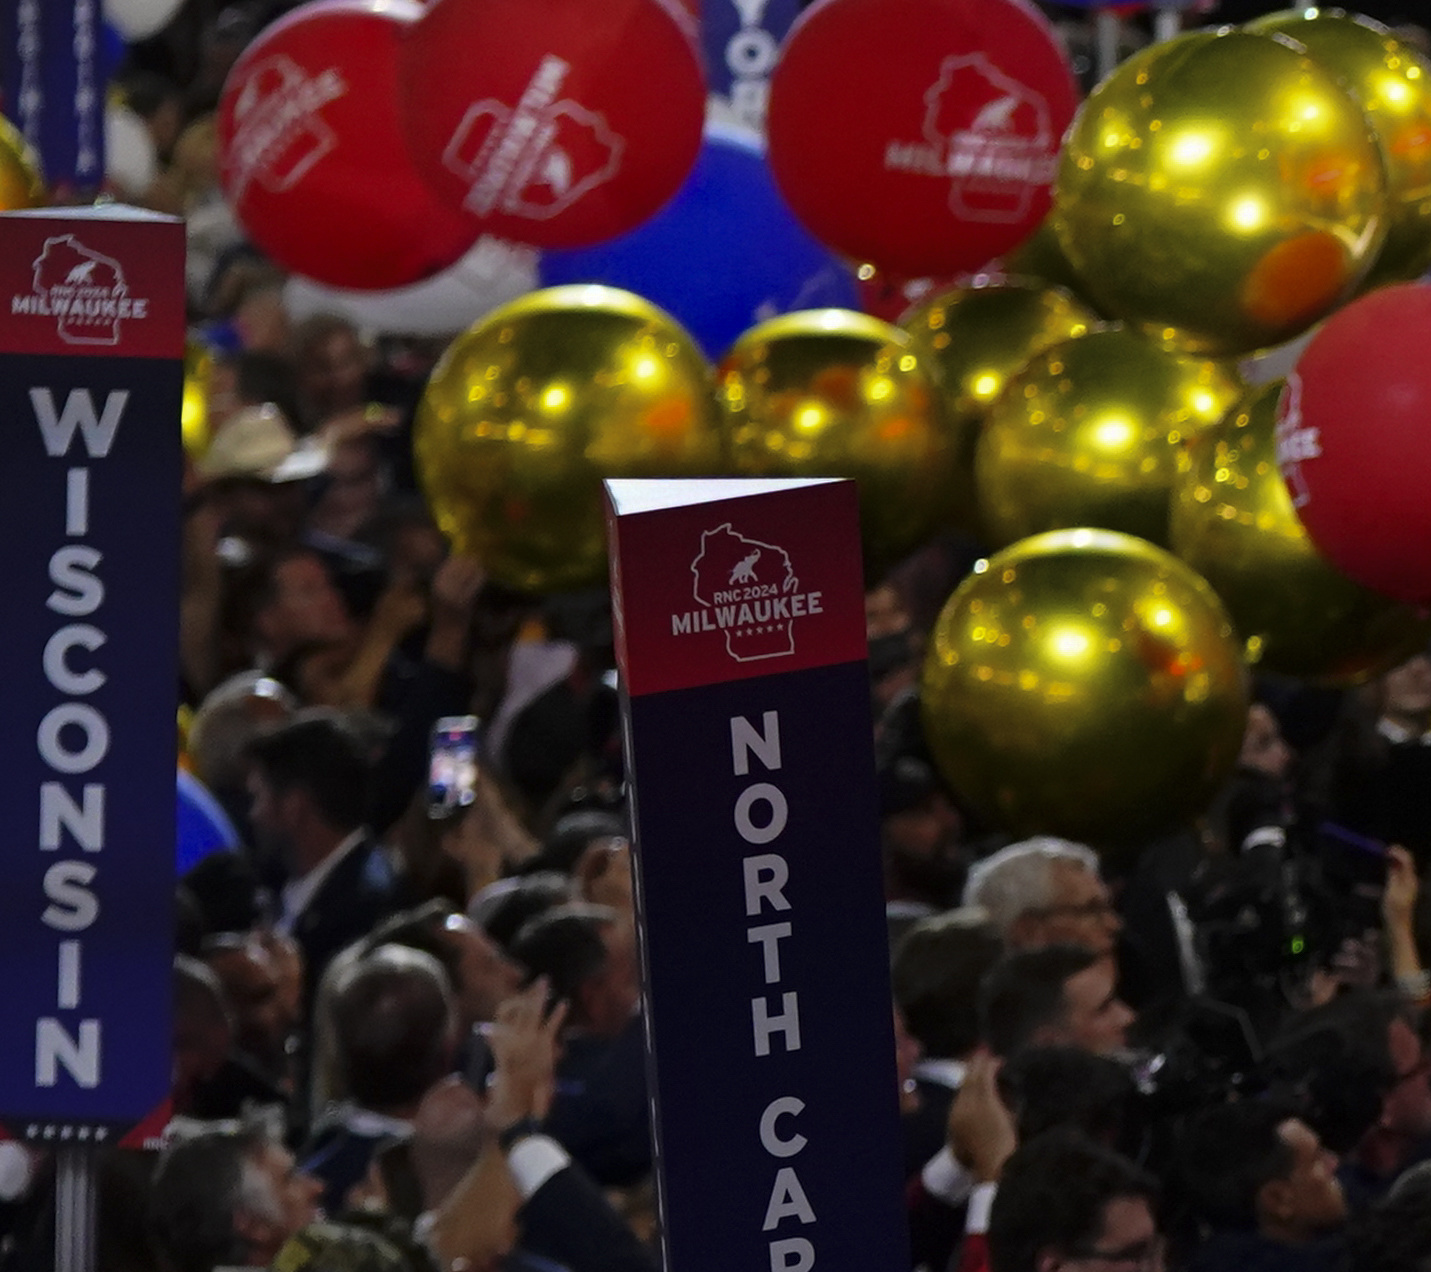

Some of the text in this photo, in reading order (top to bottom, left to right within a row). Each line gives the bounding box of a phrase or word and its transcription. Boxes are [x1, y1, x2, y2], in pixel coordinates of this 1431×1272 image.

[11, 294, 150, 319] MILWAUKEE
[672, 591, 824, 636] MILWAUKEE
[713, 584, 779, 605] RNC 2024
[29, 387, 130, 1090] WISCONSIN
[730, 709, 803, 1058] NORTH
